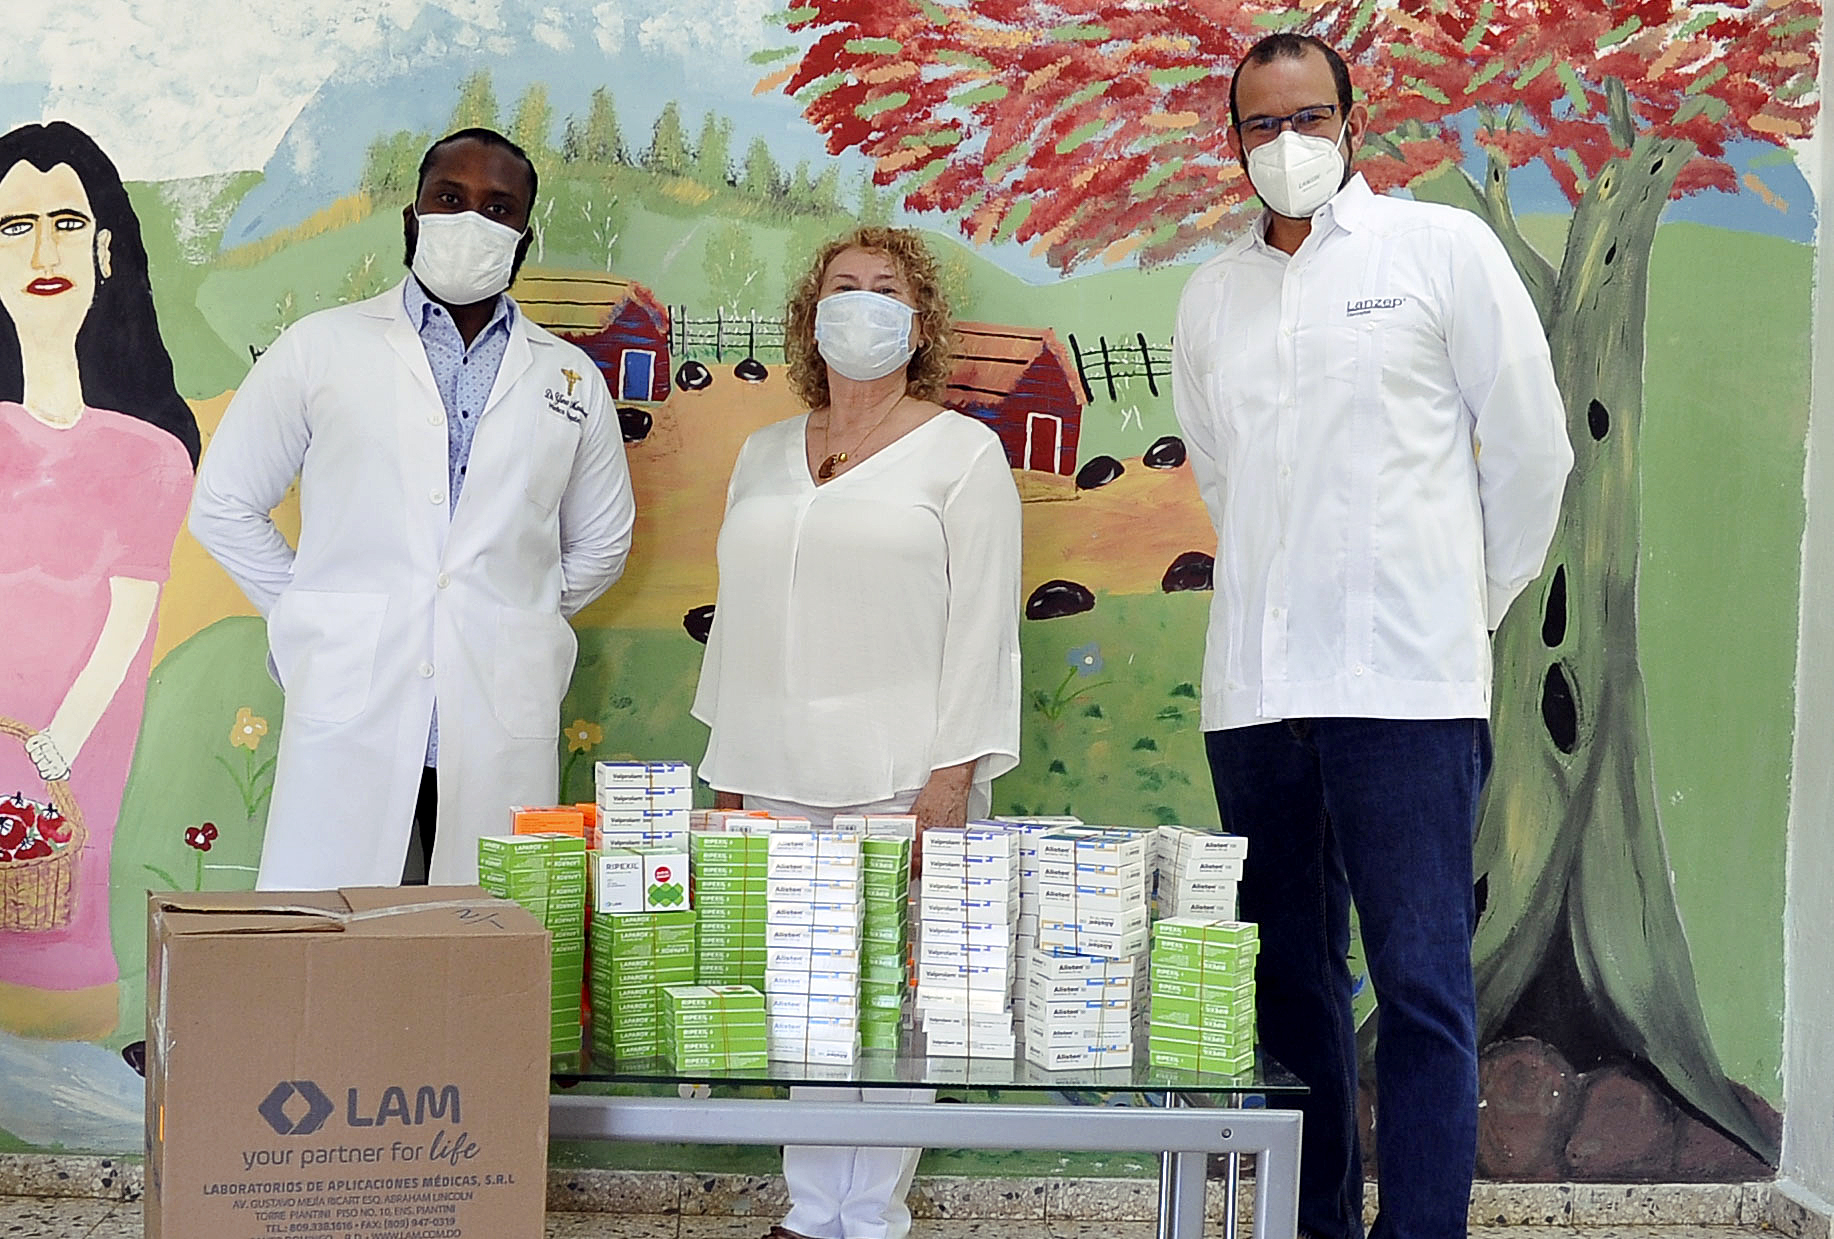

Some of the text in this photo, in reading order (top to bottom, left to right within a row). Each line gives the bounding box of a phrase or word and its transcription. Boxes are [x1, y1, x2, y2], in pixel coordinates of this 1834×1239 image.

[347, 1084, 461, 1126] LAM
[242, 1129, 481, 1171] your partner for life
[203, 1181, 303, 1195] LABORATORIOS
[306, 1181, 324, 1192] DE
[328, 1177, 419, 1191] APLICACIONES
[423, 1174, 481, 1188] MÉDICAS,
[232, 1200, 249, 1209] AV.
[250, 1198, 296, 1209] GUSTAVO
[327, 1195, 360, 1206] RICART
[384, 1193, 431, 1203] ABRAHAM
[432, 1191, 473, 1201] LINCOLN
[255, 1211, 286, 1221] TORRE
[290, 1209, 331, 1220] PIANTINI
[336, 1208, 358, 1218] PISO
[360, 1207, 378, 1217] NO.
[416, 1204, 456, 1214] PIANTINI
[360, 1220, 382, 1229] FAX:
[383, 1218, 409, 1230] (809)
[411, 1217, 456, 1227] 947-0319
